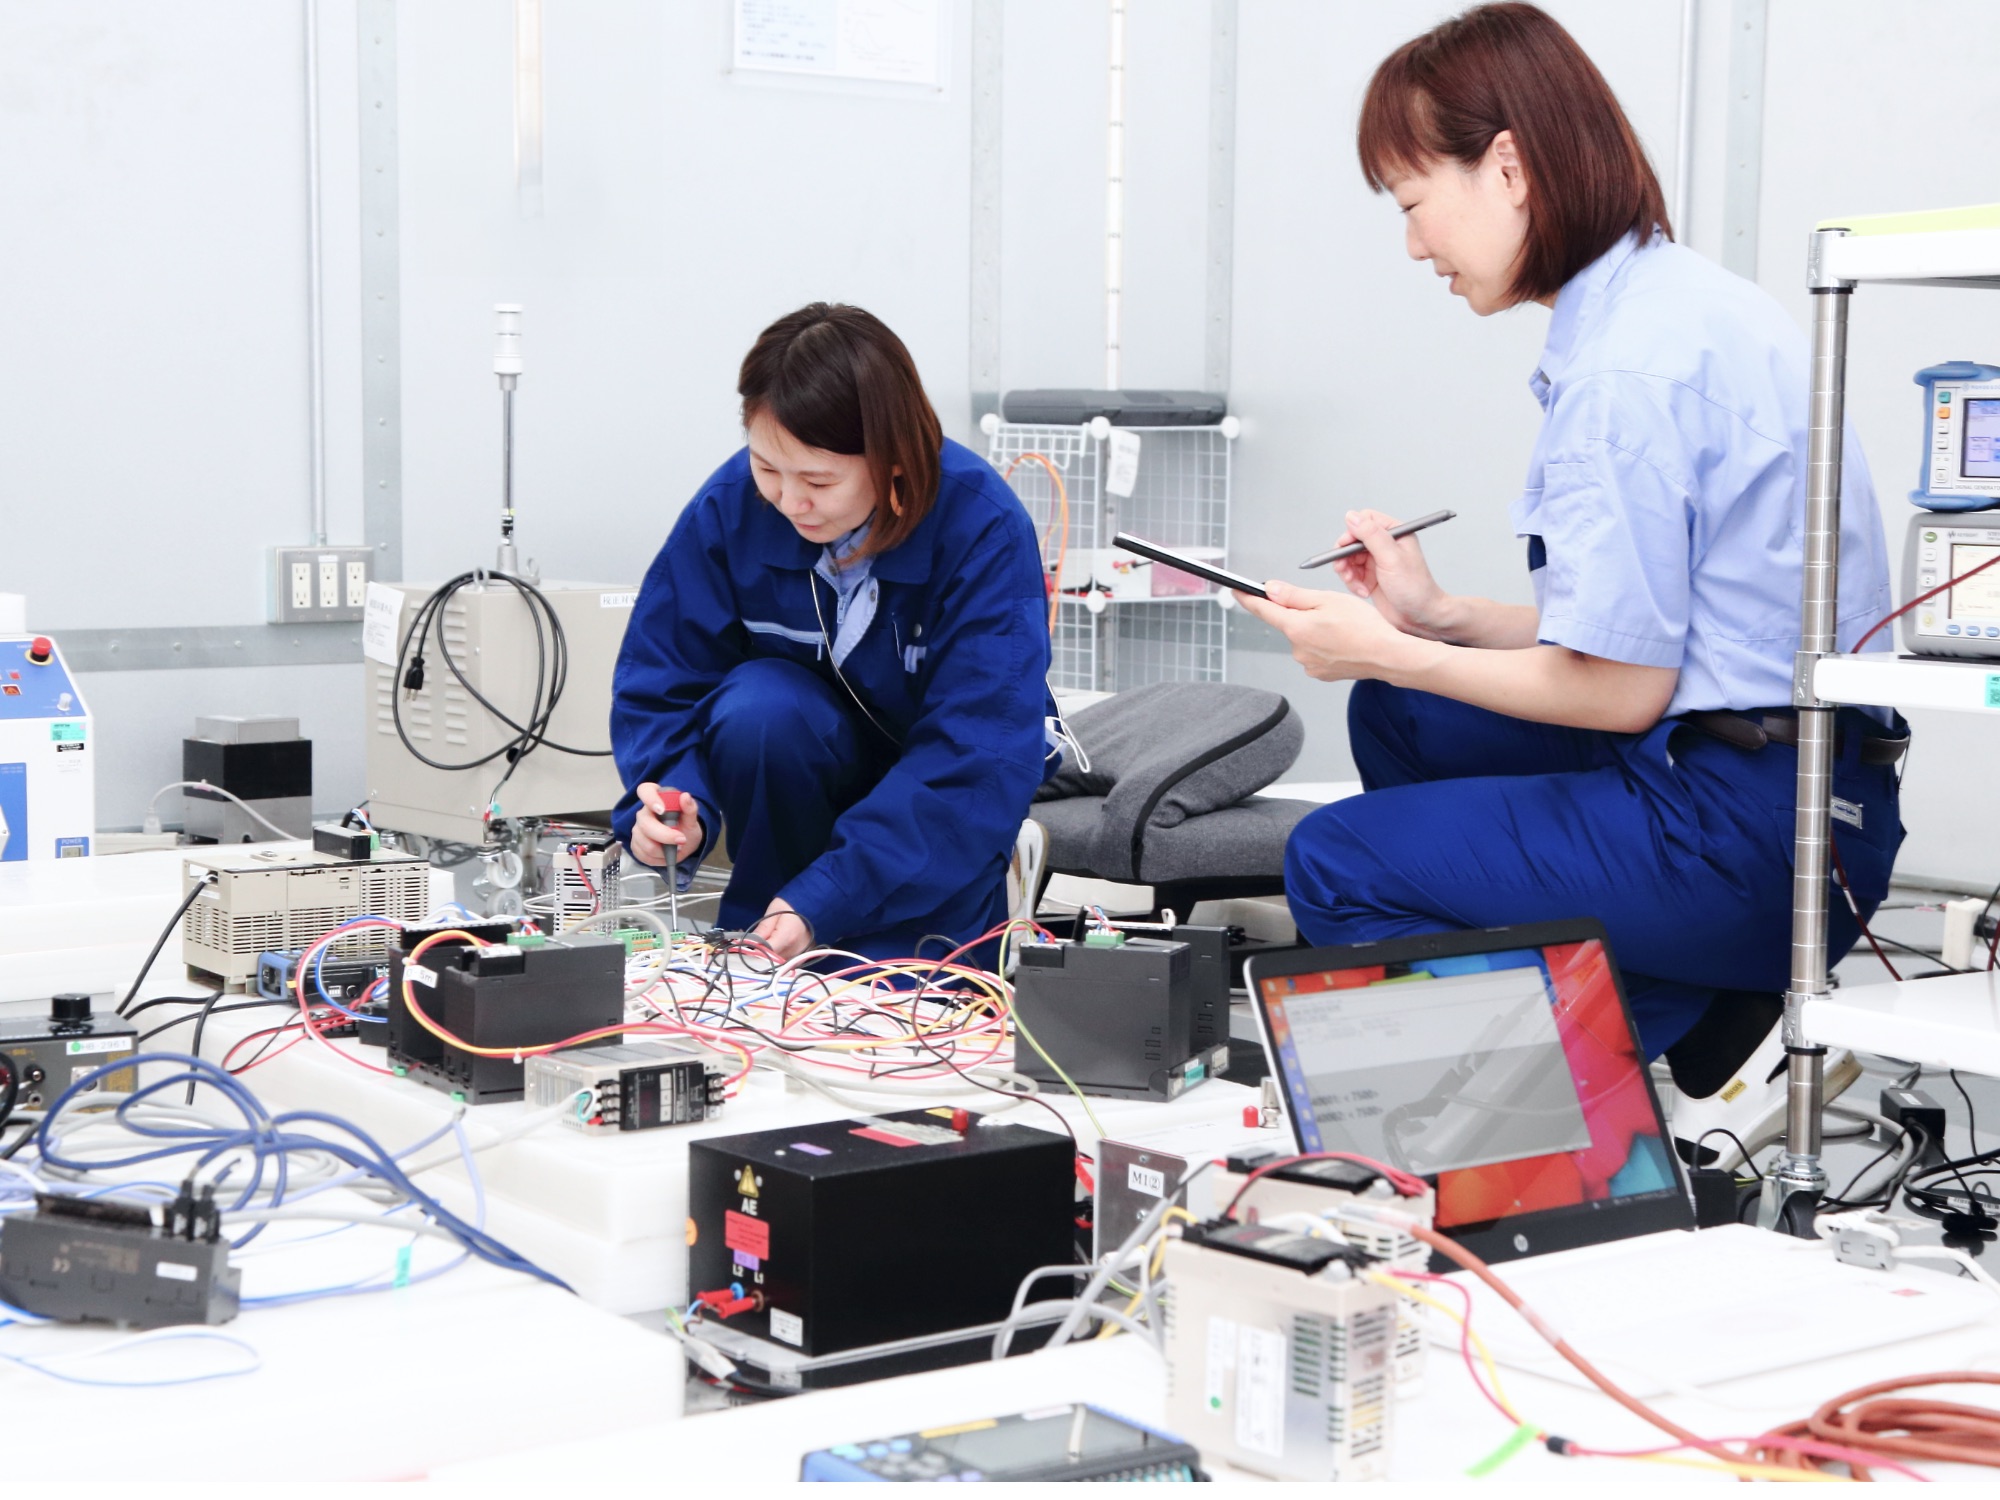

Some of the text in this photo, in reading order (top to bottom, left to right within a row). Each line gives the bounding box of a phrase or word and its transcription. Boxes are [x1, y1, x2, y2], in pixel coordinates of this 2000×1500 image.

[741, 1198, 758, 1216] AE
[733, 1264, 744, 1277] L2
[754, 1271, 764, 1285] L1
